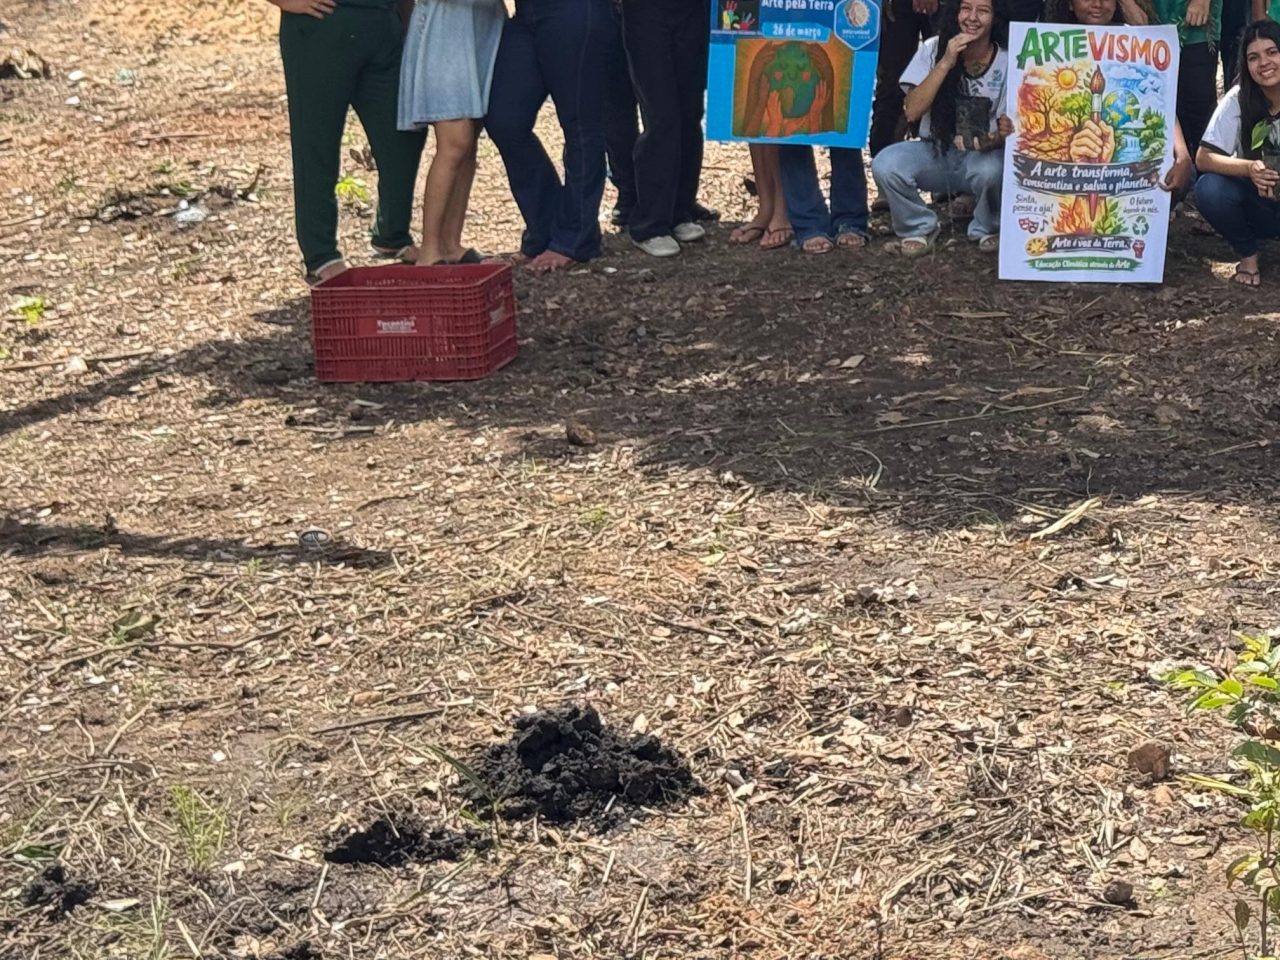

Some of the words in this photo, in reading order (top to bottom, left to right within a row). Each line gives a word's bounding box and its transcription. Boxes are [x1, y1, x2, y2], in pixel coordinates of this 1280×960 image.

[773, 24, 784, 36] 26
[786, 23, 795, 36] de
[796, 26, 822, 39] março
[1016, 27, 1171, 72] ARTEVISMO
[1030, 161, 1042, 177] A
[1044, 165, 1067, 177] arte
[1072, 165, 1133, 180] transforma,
[1022, 177, 1072, 191] conscientiza
[1075, 183, 1080, 191] e
[1082, 178, 1107, 191] salva
[1109, 183, 1113, 191] o
[1115, 177, 1152, 195] planeta.
[1012, 204, 1032, 214] pense
[1129, 196, 1135, 205] O
[1136, 196, 1154, 208] futuro
[1052, 237, 1071, 249] Arte
[1078, 240, 1092, 248] voz
[1093, 238, 1101, 247] da
[1115, 259, 1131, 268] Arte
